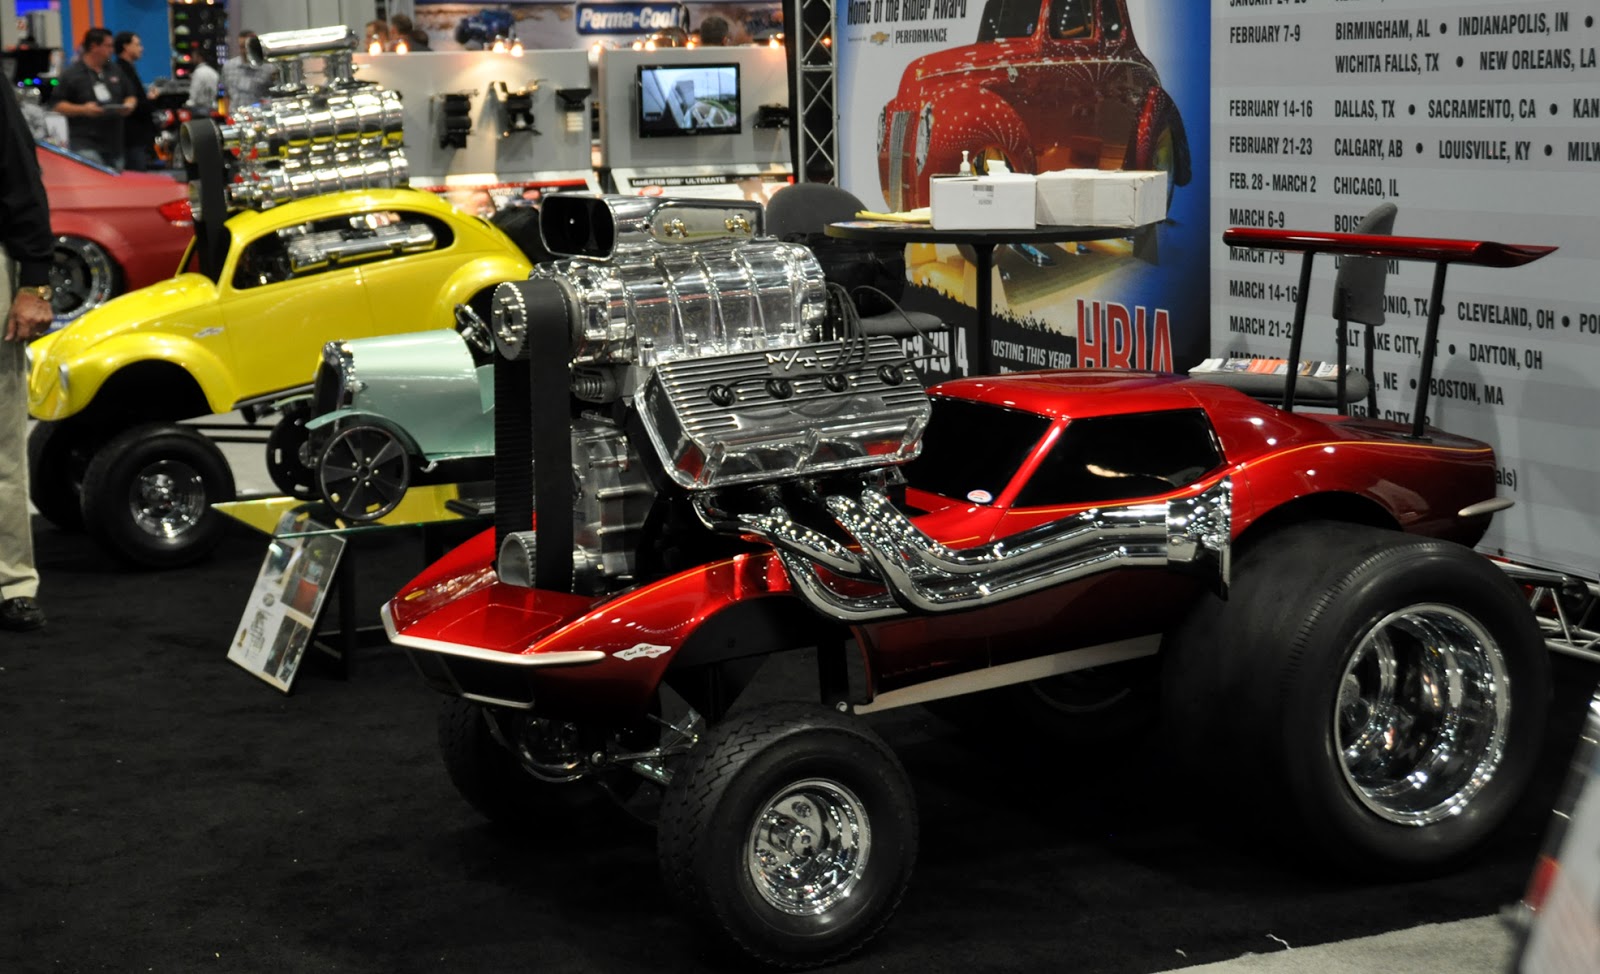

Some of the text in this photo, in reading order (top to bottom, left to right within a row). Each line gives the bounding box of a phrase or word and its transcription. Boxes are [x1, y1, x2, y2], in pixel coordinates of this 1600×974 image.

[579, 7, 677, 29] Perma-Cool
[1335, 12, 1568, 41] BIRMINGHAM, AL INDIANAPOLIS, IN
[895, 28, 948, 43] PERFORMANCE
[1229, 24, 1301, 44] FEBRUARY 7-9
[1335, 47, 1597, 75] WICHITA FALLS, TX NEW ORLEANS, LA
[1229, 99, 1313, 117] FEBRUARY 14-16
[1335, 98, 1600, 121] DALLAS, TX SACRAMENTO, CA KAN
[1229, 136, 1313, 155] FEBRUARY 21-23
[1334, 138, 1600, 163] CALGARY, AB LOUISVILLE, KY MILW
[685, 176, 726, 184] ULTIMATE
[1229, 172, 1249, 189] FEB.
[1251, 173, 1263, 190] 28
[1272, 174, 1307, 192] MARCH
[1310, 176, 1317, 193] 2
[1334, 176, 1399, 199] CHICAGO, IL
[1229, 208, 1285, 228] MARCH 6-9
[1334, 215, 1364, 233] BOIS
[1229, 247, 1265, 263] MARCH
[1229, 280, 1298, 303] MARCH 14-16
[1383, 294, 1411, 318] ONIO,
[1413, 297, 1429, 317] TX
[1457, 301, 1532, 330] CLEVELAND,
[1536, 309, 1555, 330] OH
[1229, 315, 1293, 339] MARCH 21-2
[928, 326, 969, 377] 204
[991, 339, 1072, 369] OSTING THIS YEAR
[1394, 334, 1421, 358] CITY,
[1469, 343, 1521, 370] DAYTON,
[1524, 349, 1543, 370] OH
[1383, 372, 1505, 405] NE BOSTON, MA
[1495, 466, 1517, 491] als)
